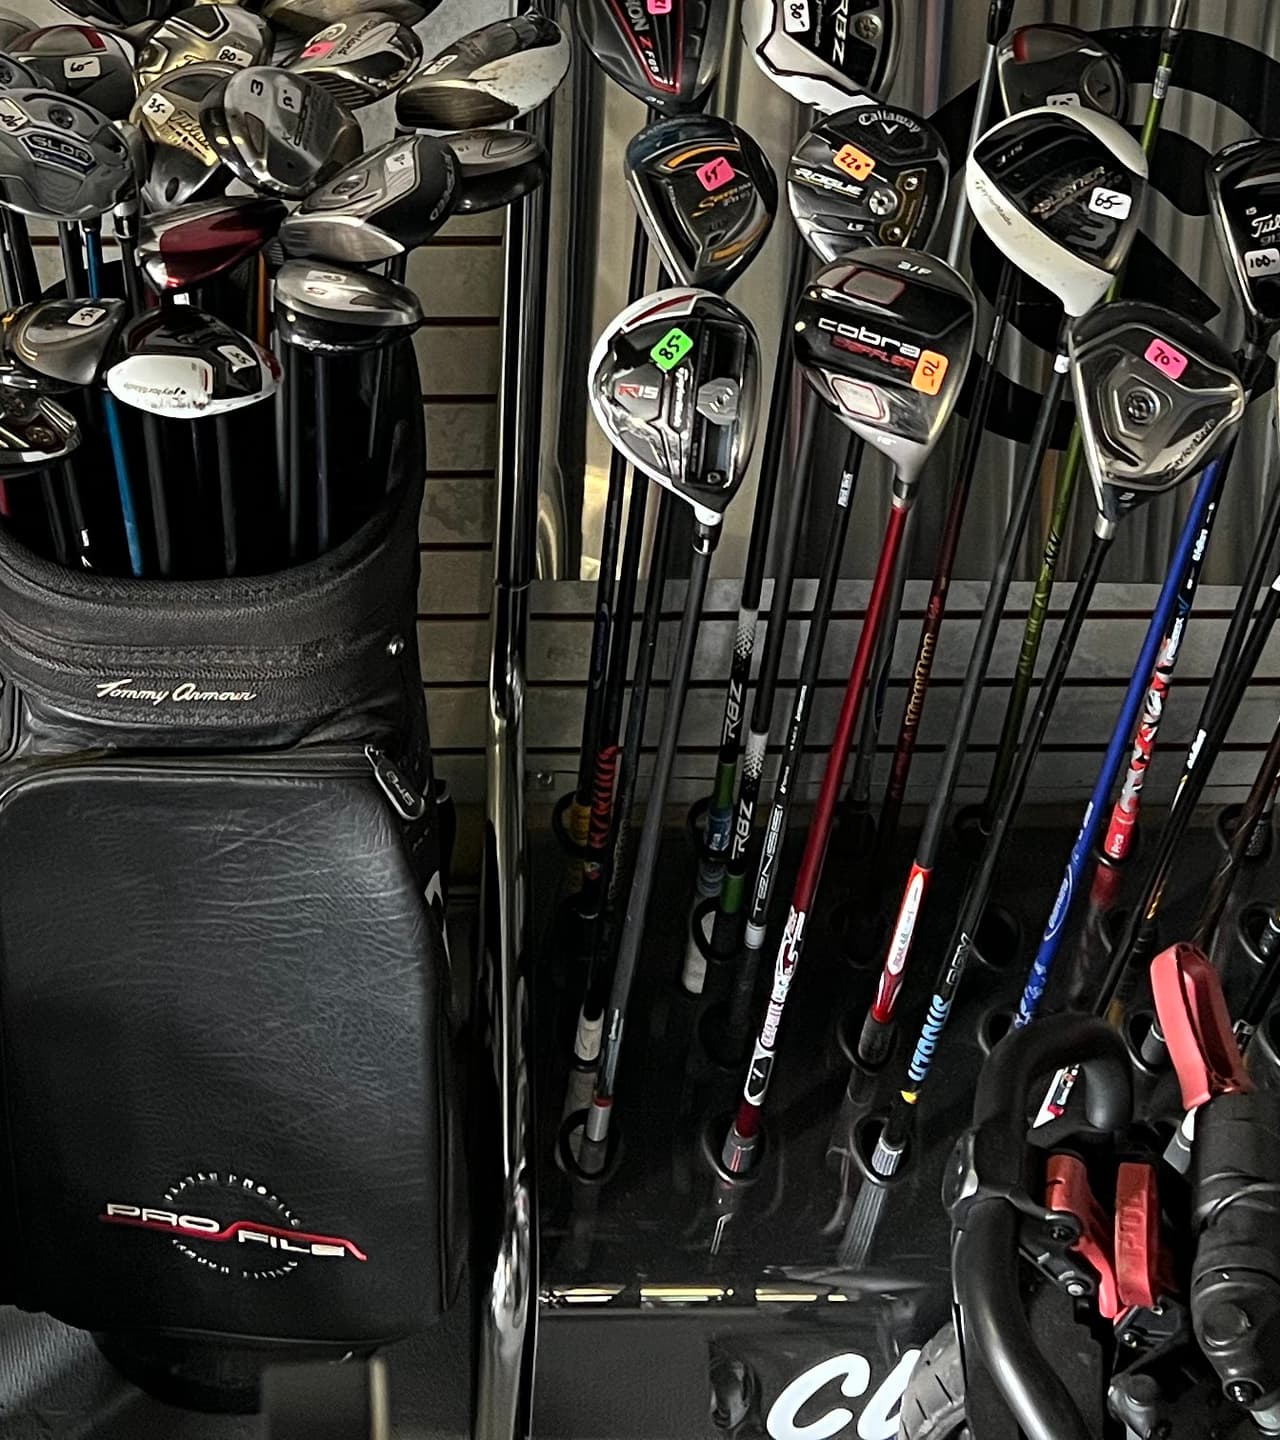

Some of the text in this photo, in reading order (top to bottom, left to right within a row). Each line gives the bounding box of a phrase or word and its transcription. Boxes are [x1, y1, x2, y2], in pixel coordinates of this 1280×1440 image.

[639, 35, 653, 48] Z
[250, 79, 265, 96] 3
[858, 111, 922, 134] Callaway
[30, 134, 92, 162] SLDR
[793, 167, 865, 197] ROGUE
[847, 221, 865, 232] LS
[817, 316, 921, 358] cobra
[1153, 346, 1181, 366] 70-
[618, 382, 659, 399] R15
[96, 678, 257, 705] Tommy Armour
[723, 678, 743, 746] RBZ
[731, 799, 754, 861] RBZ
[106, 1202, 220, 1233] PRO
[236, 1229, 345, 1258] FILE
